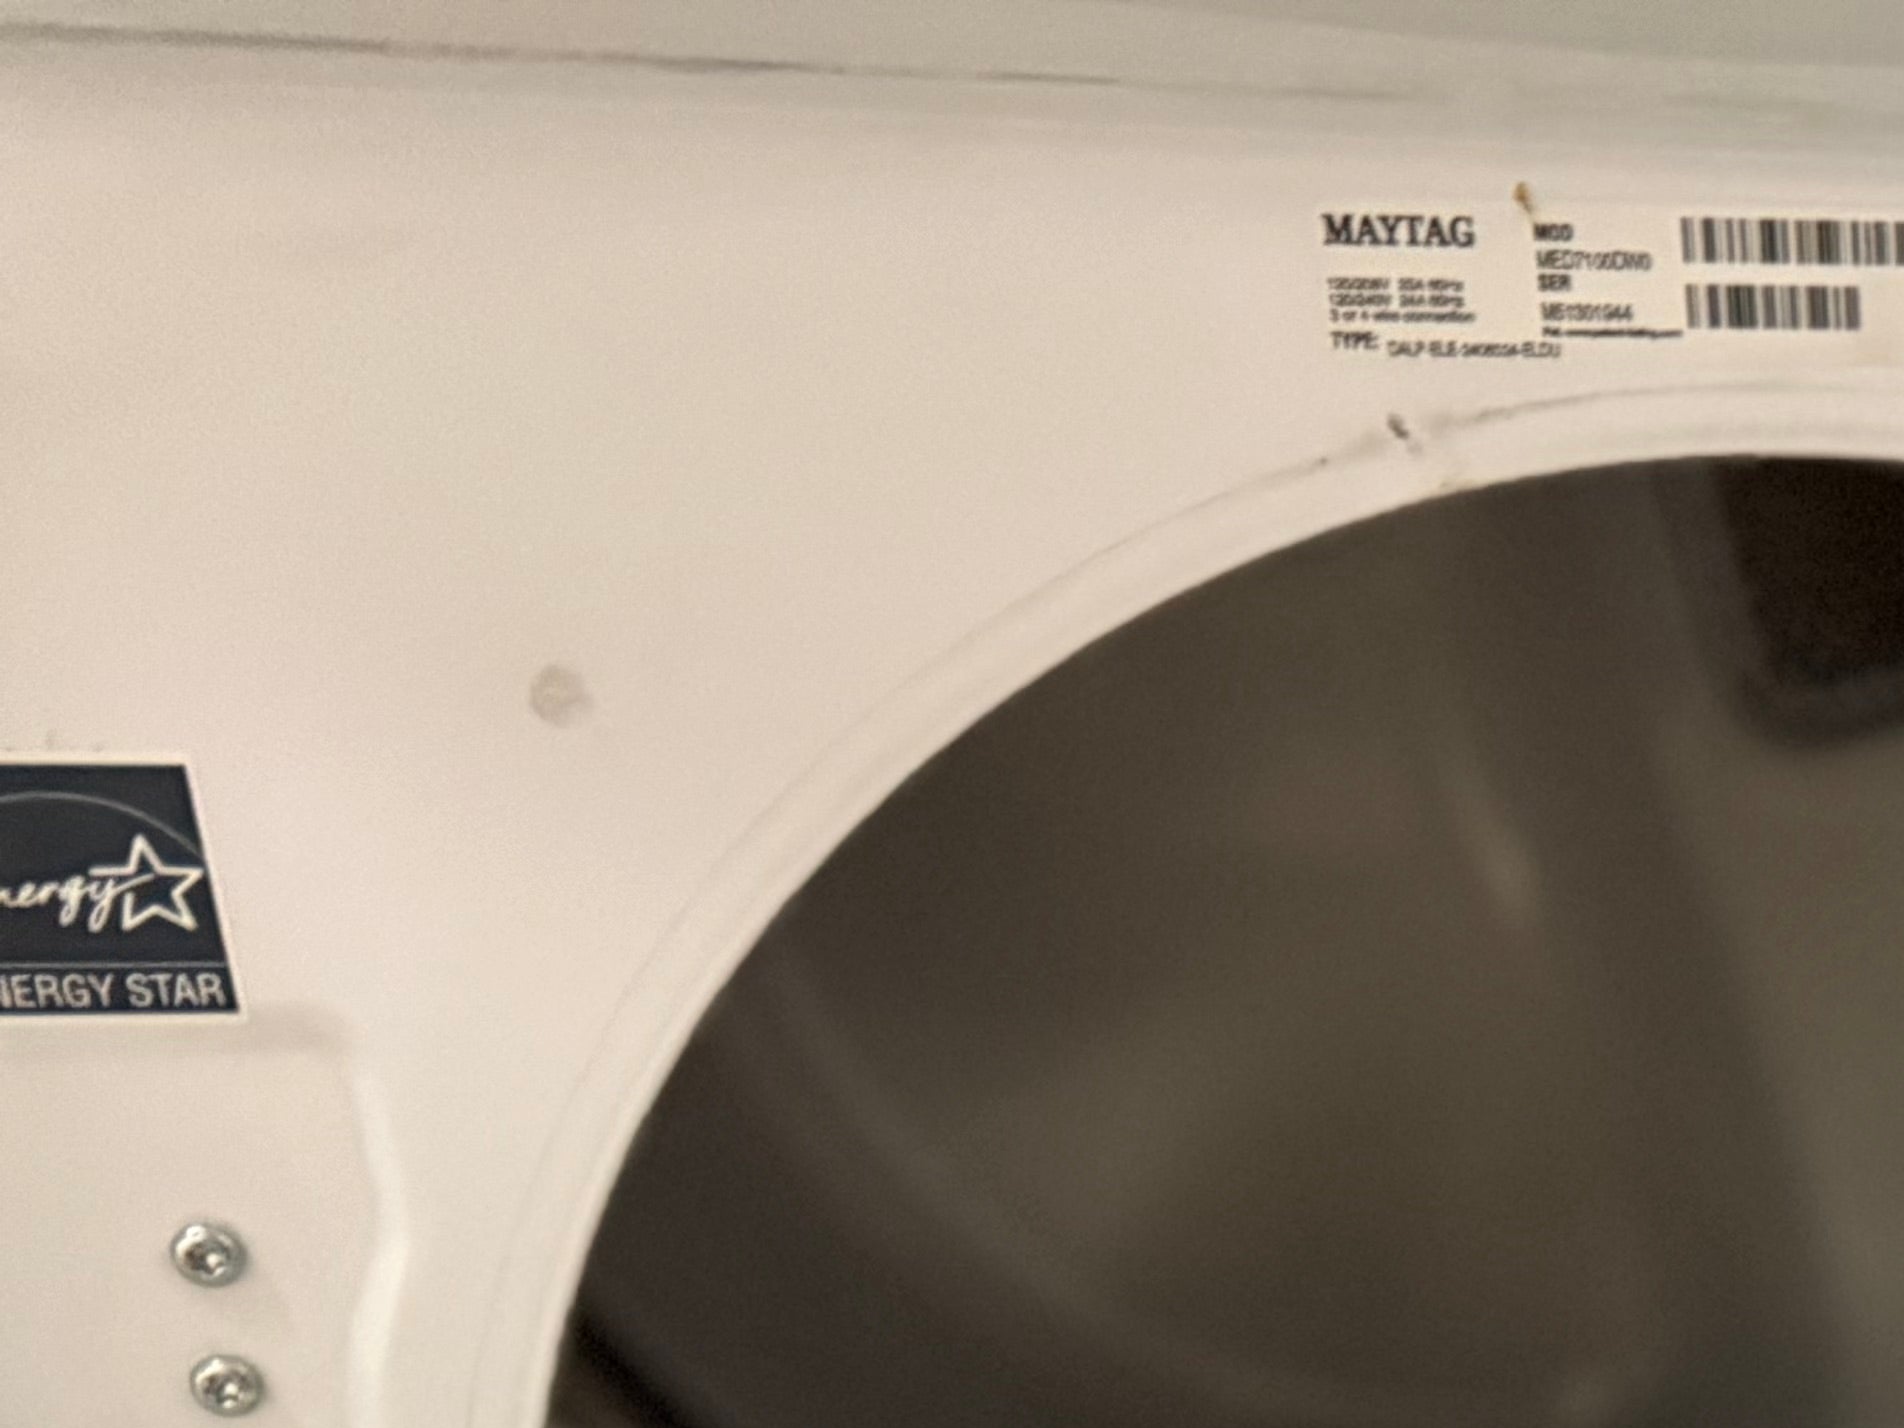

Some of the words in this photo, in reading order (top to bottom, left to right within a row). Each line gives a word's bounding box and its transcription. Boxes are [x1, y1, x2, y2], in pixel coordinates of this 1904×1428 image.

[1322, 213, 1475, 247] MAYTAG
[1533, 222, 1574, 242] MOD
[1537, 274, 1572, 292] SER
[1342, 311, 1356, 322] or
[125, 974, 228, 1008] STAR
